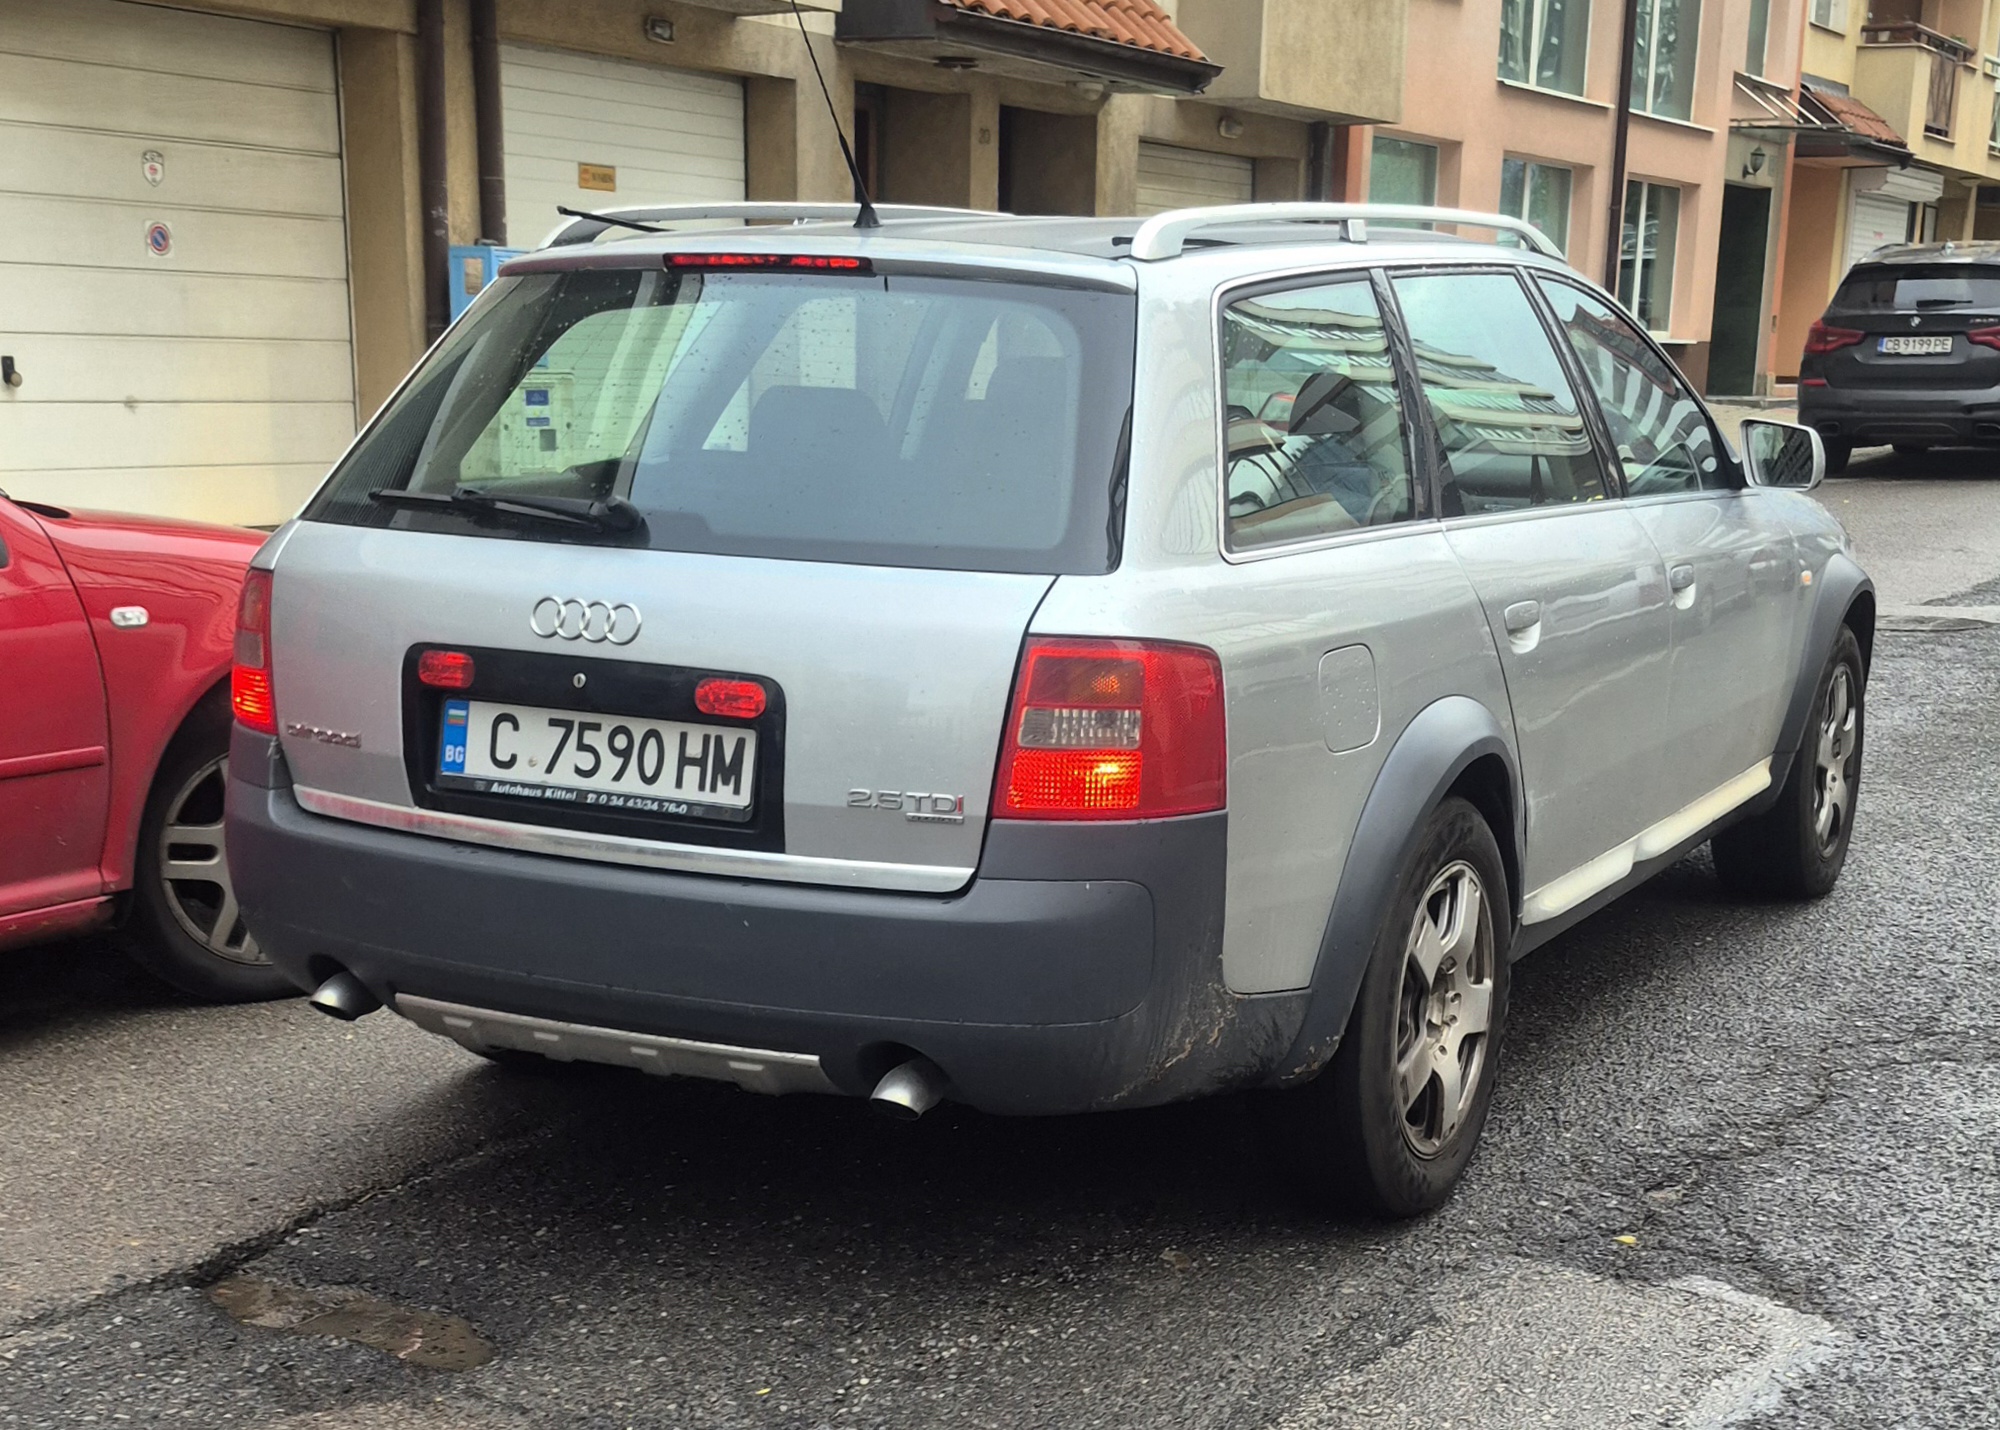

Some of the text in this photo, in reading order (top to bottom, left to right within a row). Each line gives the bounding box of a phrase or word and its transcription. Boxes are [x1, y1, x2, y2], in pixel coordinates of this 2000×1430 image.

[1903, 338, 1932, 351] 9199
[1934, 338, 1950, 351] PE
[444, 744, 464, 763] BG
[490, 712, 747, 797] C 7590 HM
[490, 782, 542, 797] Autohaus
[847, 788, 965, 814] 2.5 TDI
